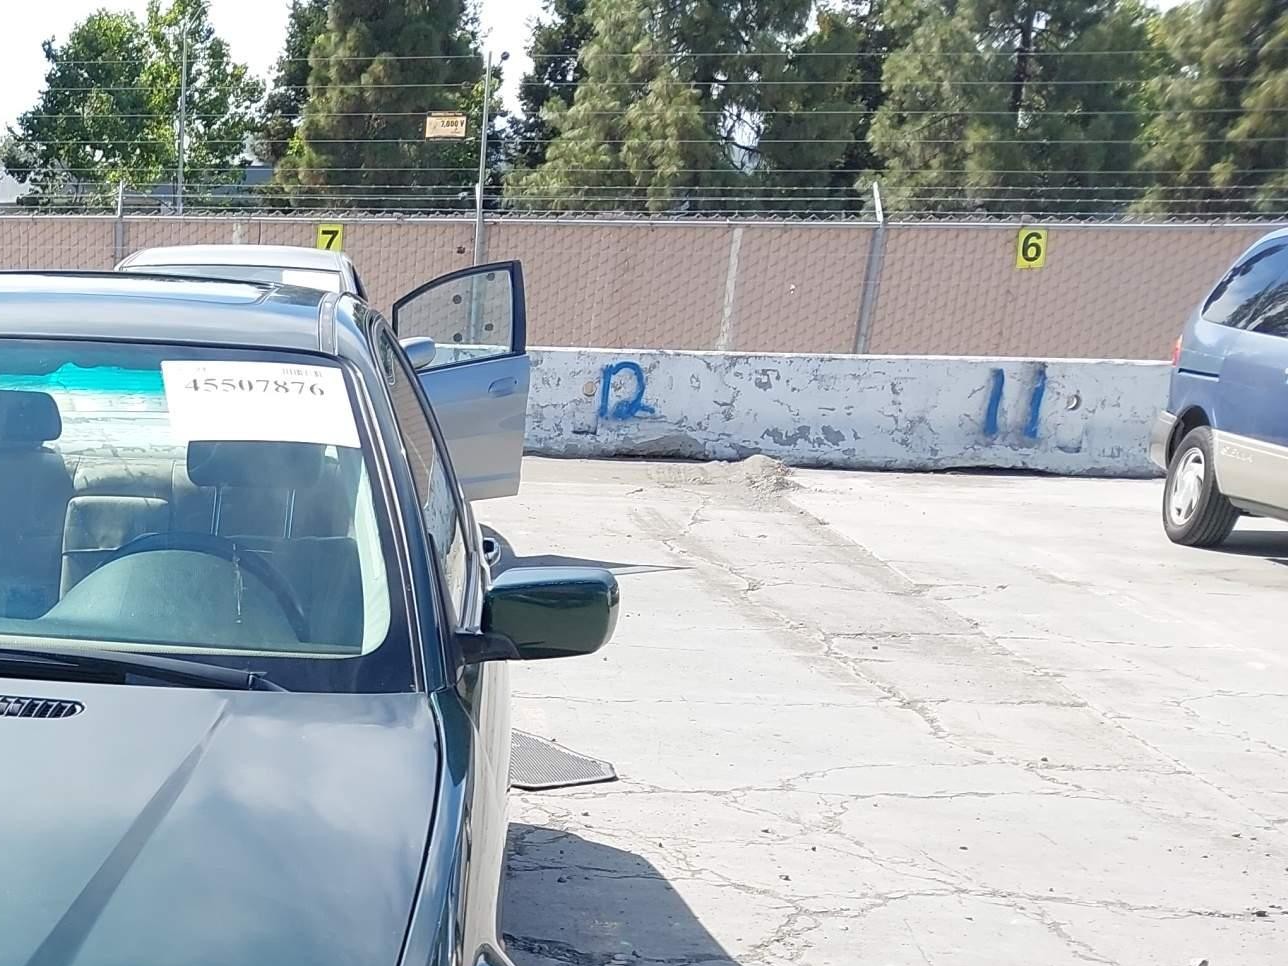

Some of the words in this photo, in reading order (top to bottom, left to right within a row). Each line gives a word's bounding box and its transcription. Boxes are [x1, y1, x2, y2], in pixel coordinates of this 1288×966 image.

[322, 230, 339, 250] 7
[1022, 232, 1042, 262] 6
[184, 378, 325, 396] 45507876
